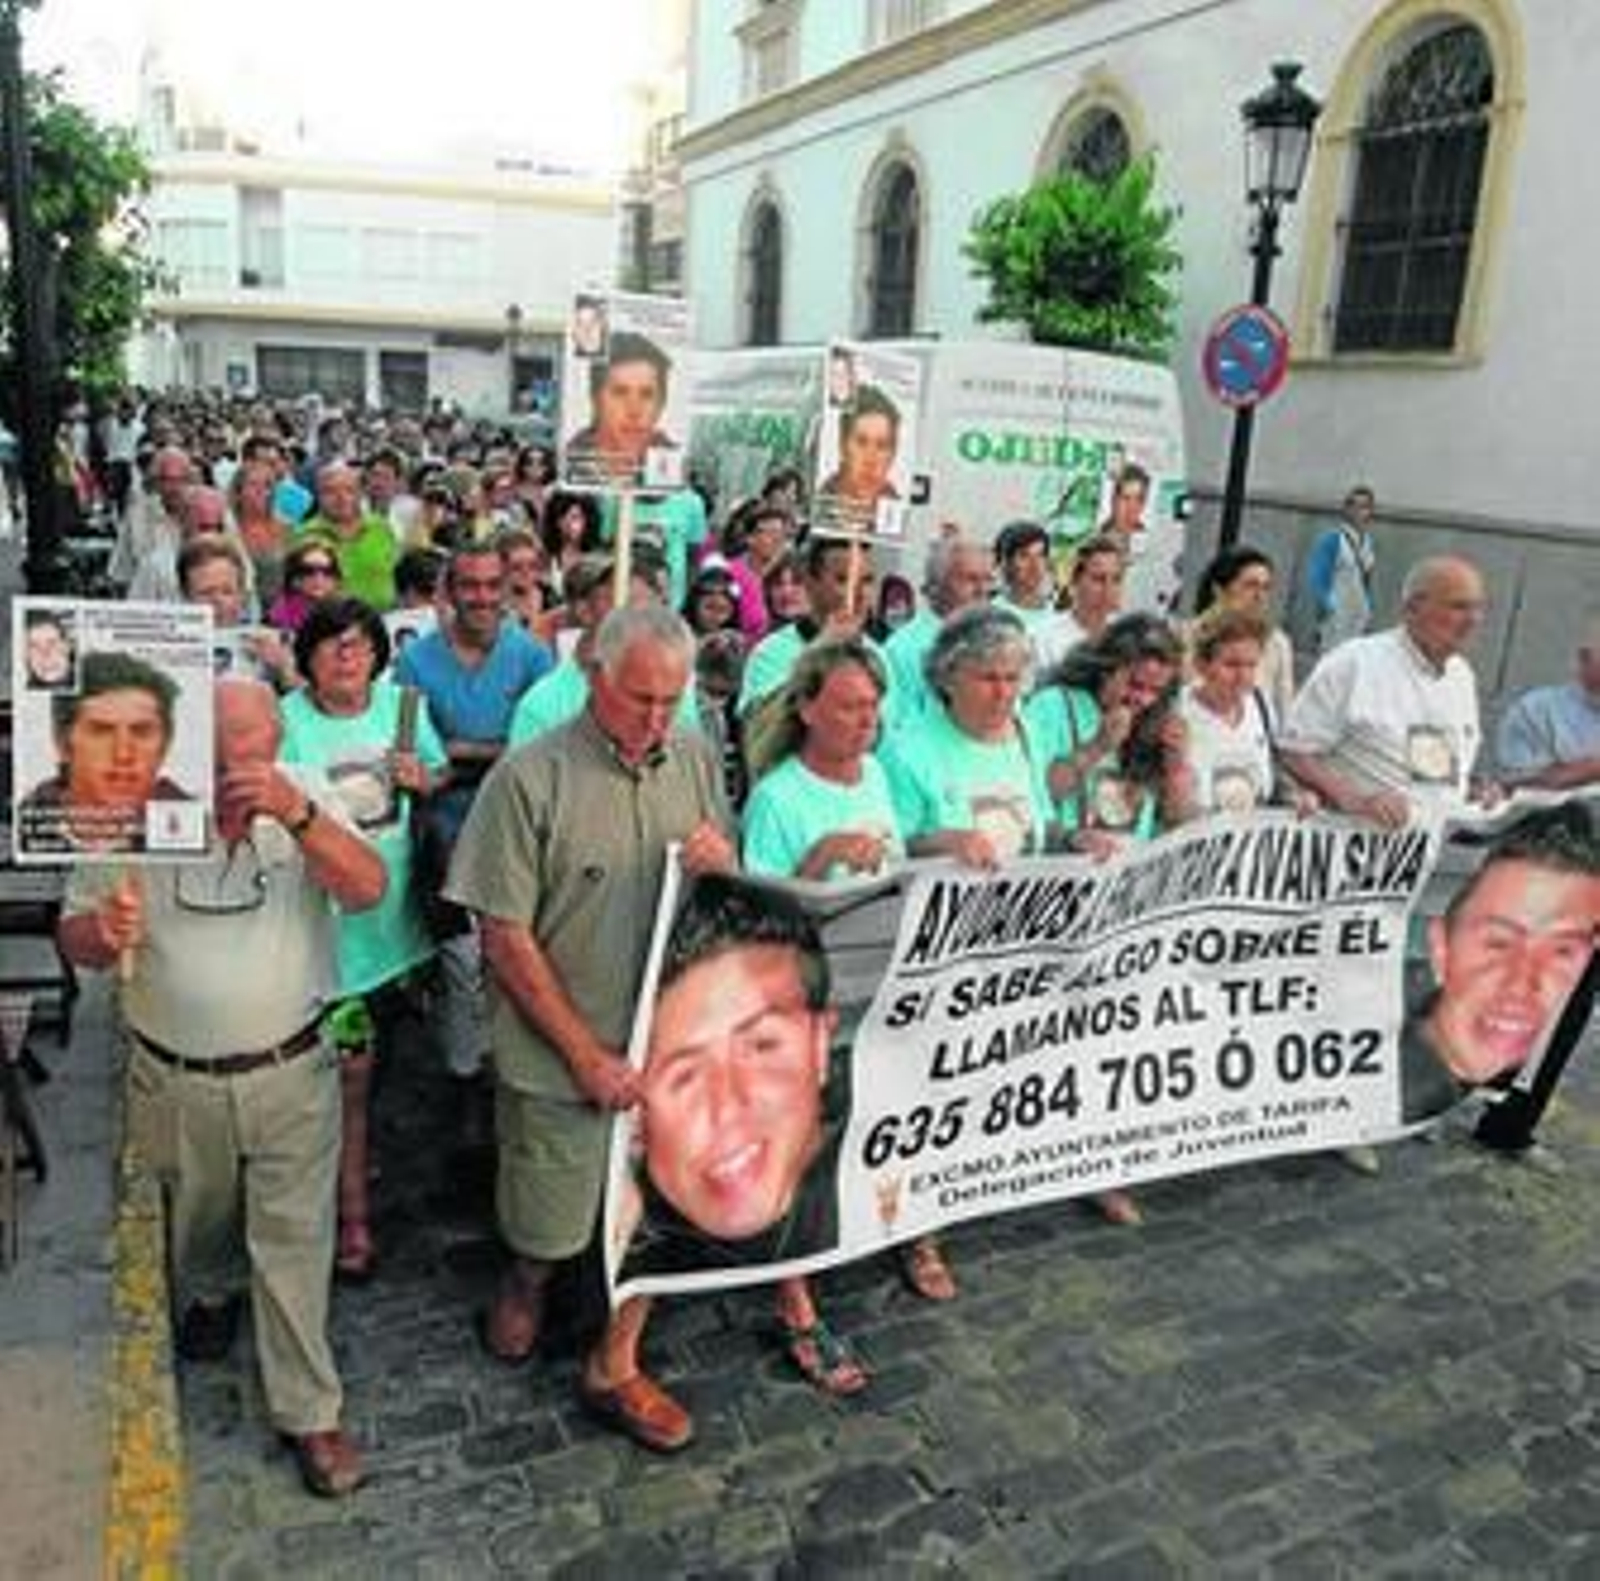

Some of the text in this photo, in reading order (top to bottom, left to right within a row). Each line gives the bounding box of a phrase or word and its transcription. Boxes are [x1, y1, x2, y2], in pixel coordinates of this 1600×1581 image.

[947, 962, 1062, 1020] SABE
[1062, 938, 1160, 993] ALGO
[1168, 920, 1322, 966] SOBRE
[1338, 909, 1390, 956] ÉL
[928, 976, 1318, 1080] LLAMANOS AL TLF:
[861, 1028, 1383, 1169] 635 884 705 Ó 062
